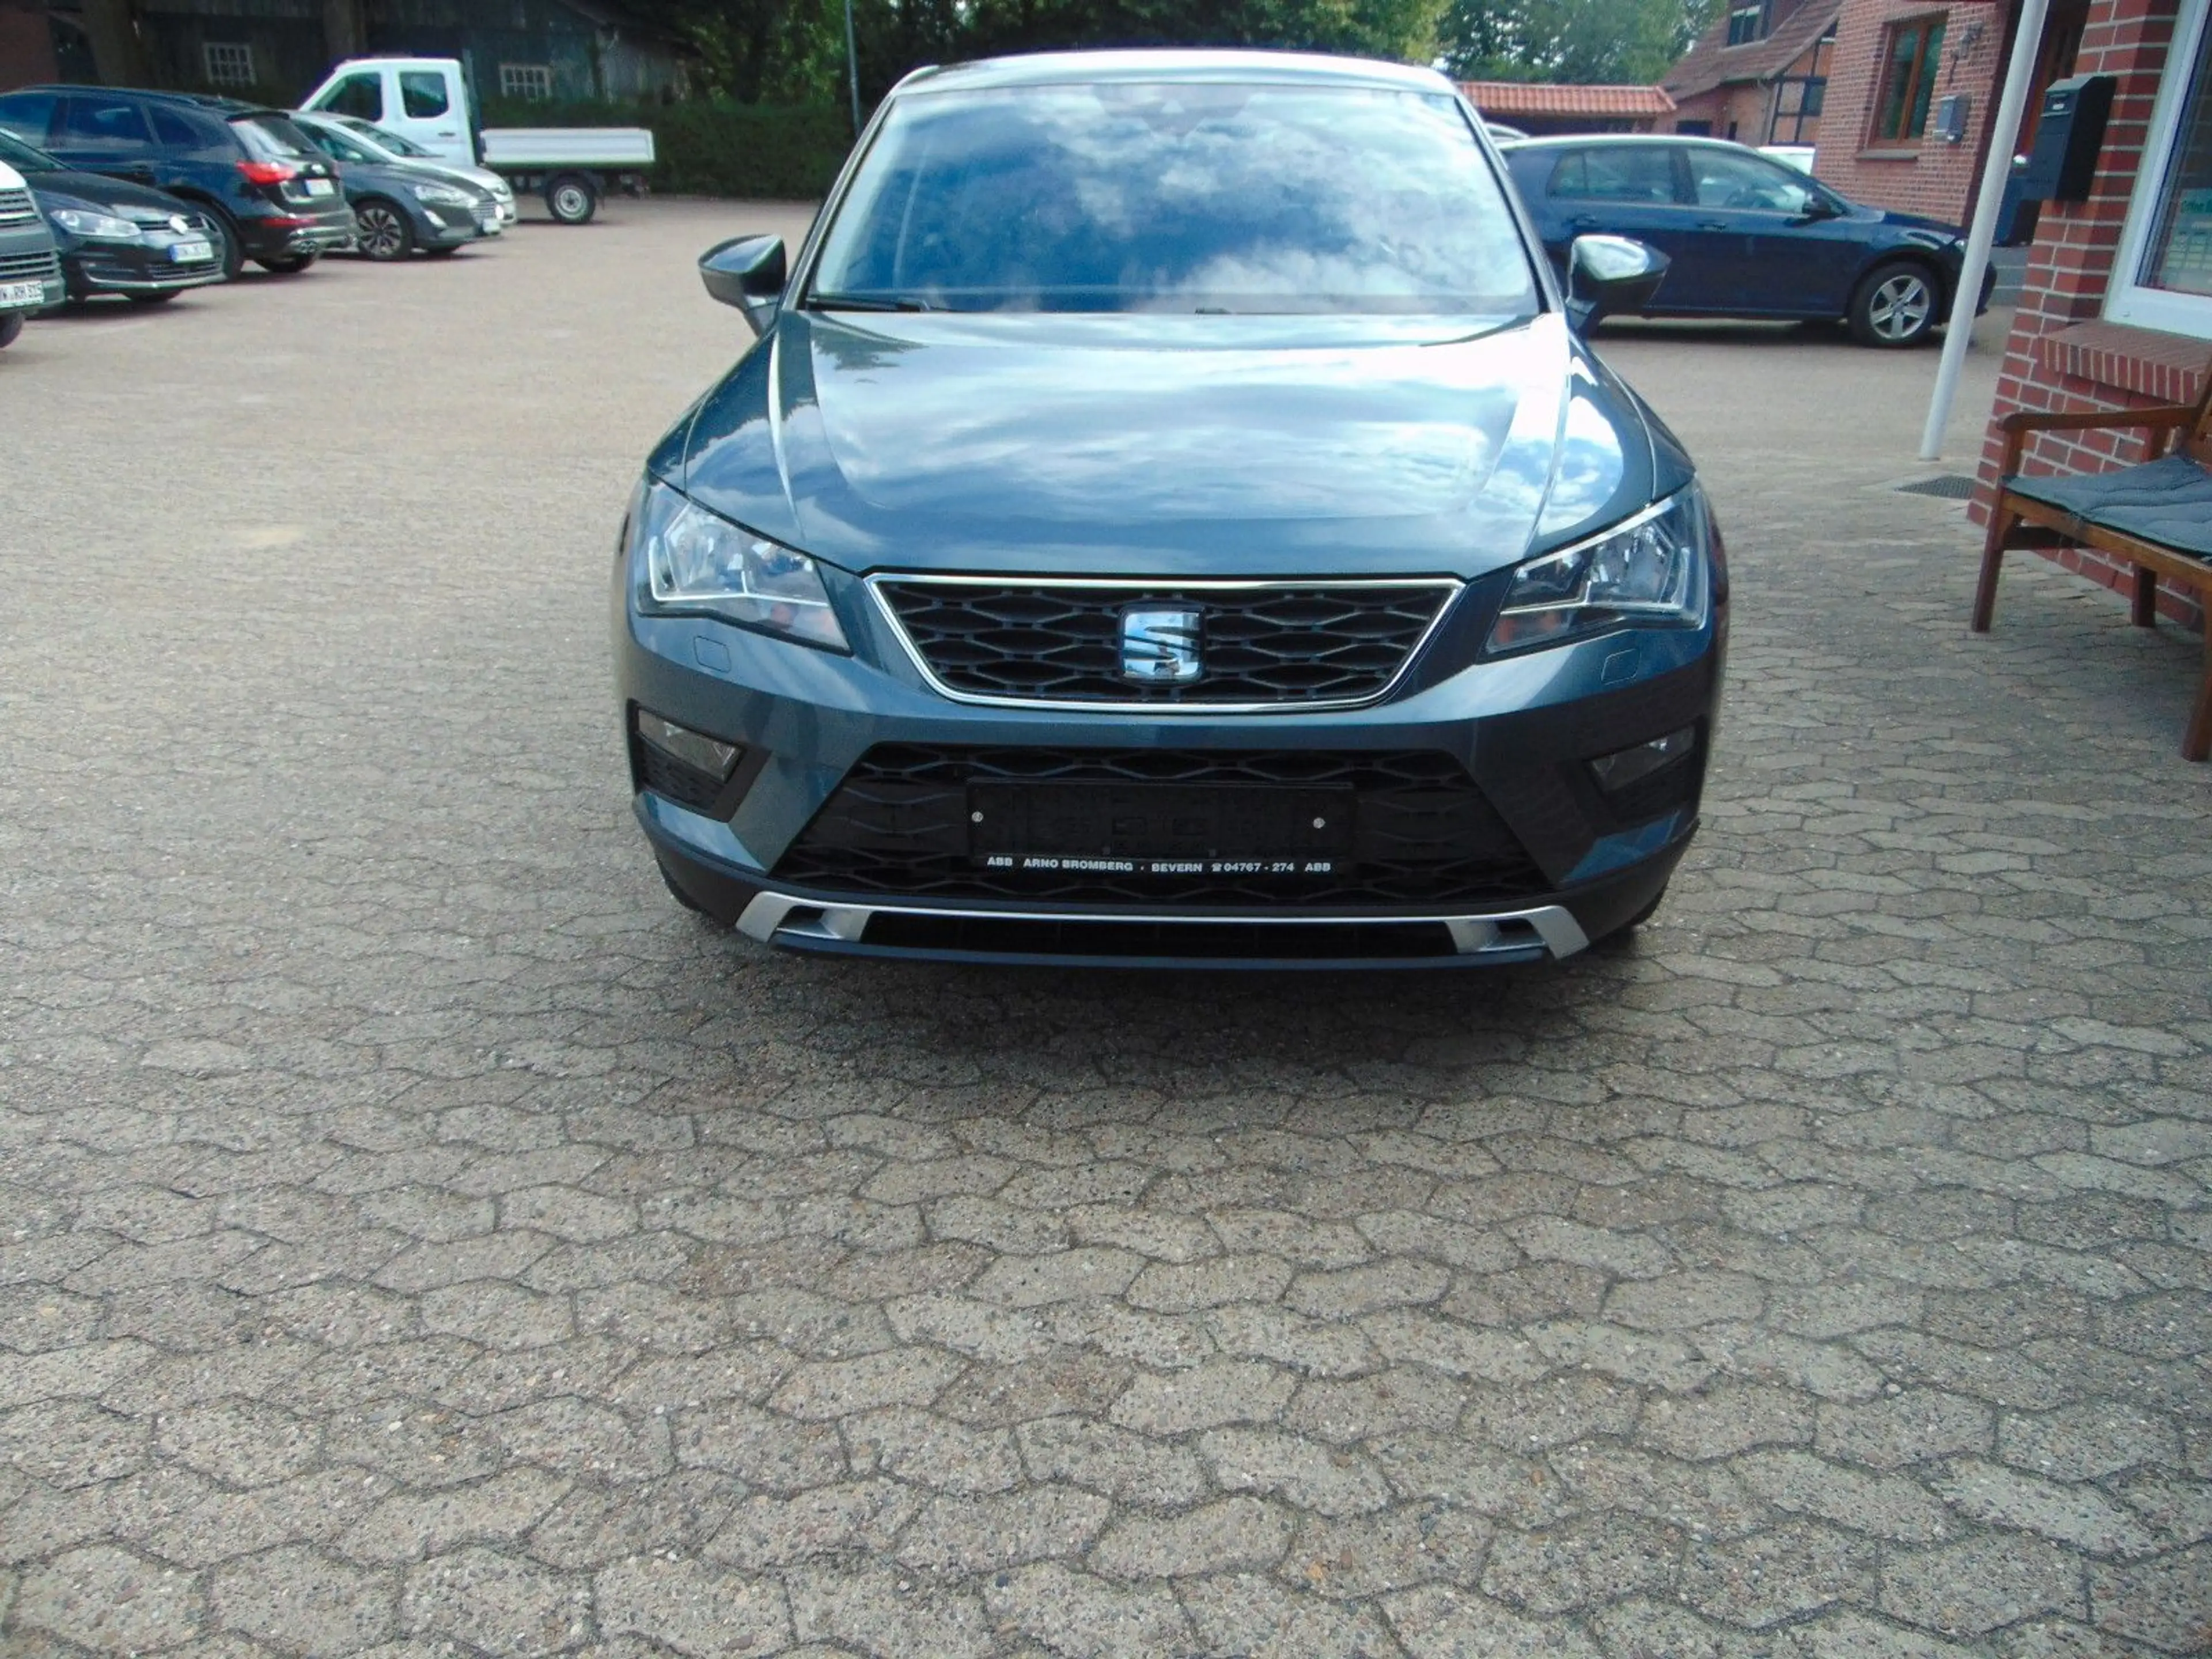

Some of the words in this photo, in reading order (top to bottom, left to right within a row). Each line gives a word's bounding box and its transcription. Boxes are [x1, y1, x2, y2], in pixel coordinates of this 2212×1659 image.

[987, 856, 1013, 866] ABB
[1022, 858, 1059, 868] ARNO
[1062, 859, 1134, 871] BROMBERG
[1152, 863, 1203, 872] BEVERN
[1224, 862, 1262, 872] 04767
[1272, 862, 1295, 872] 274
[1305, 862, 1331, 872] ABB
